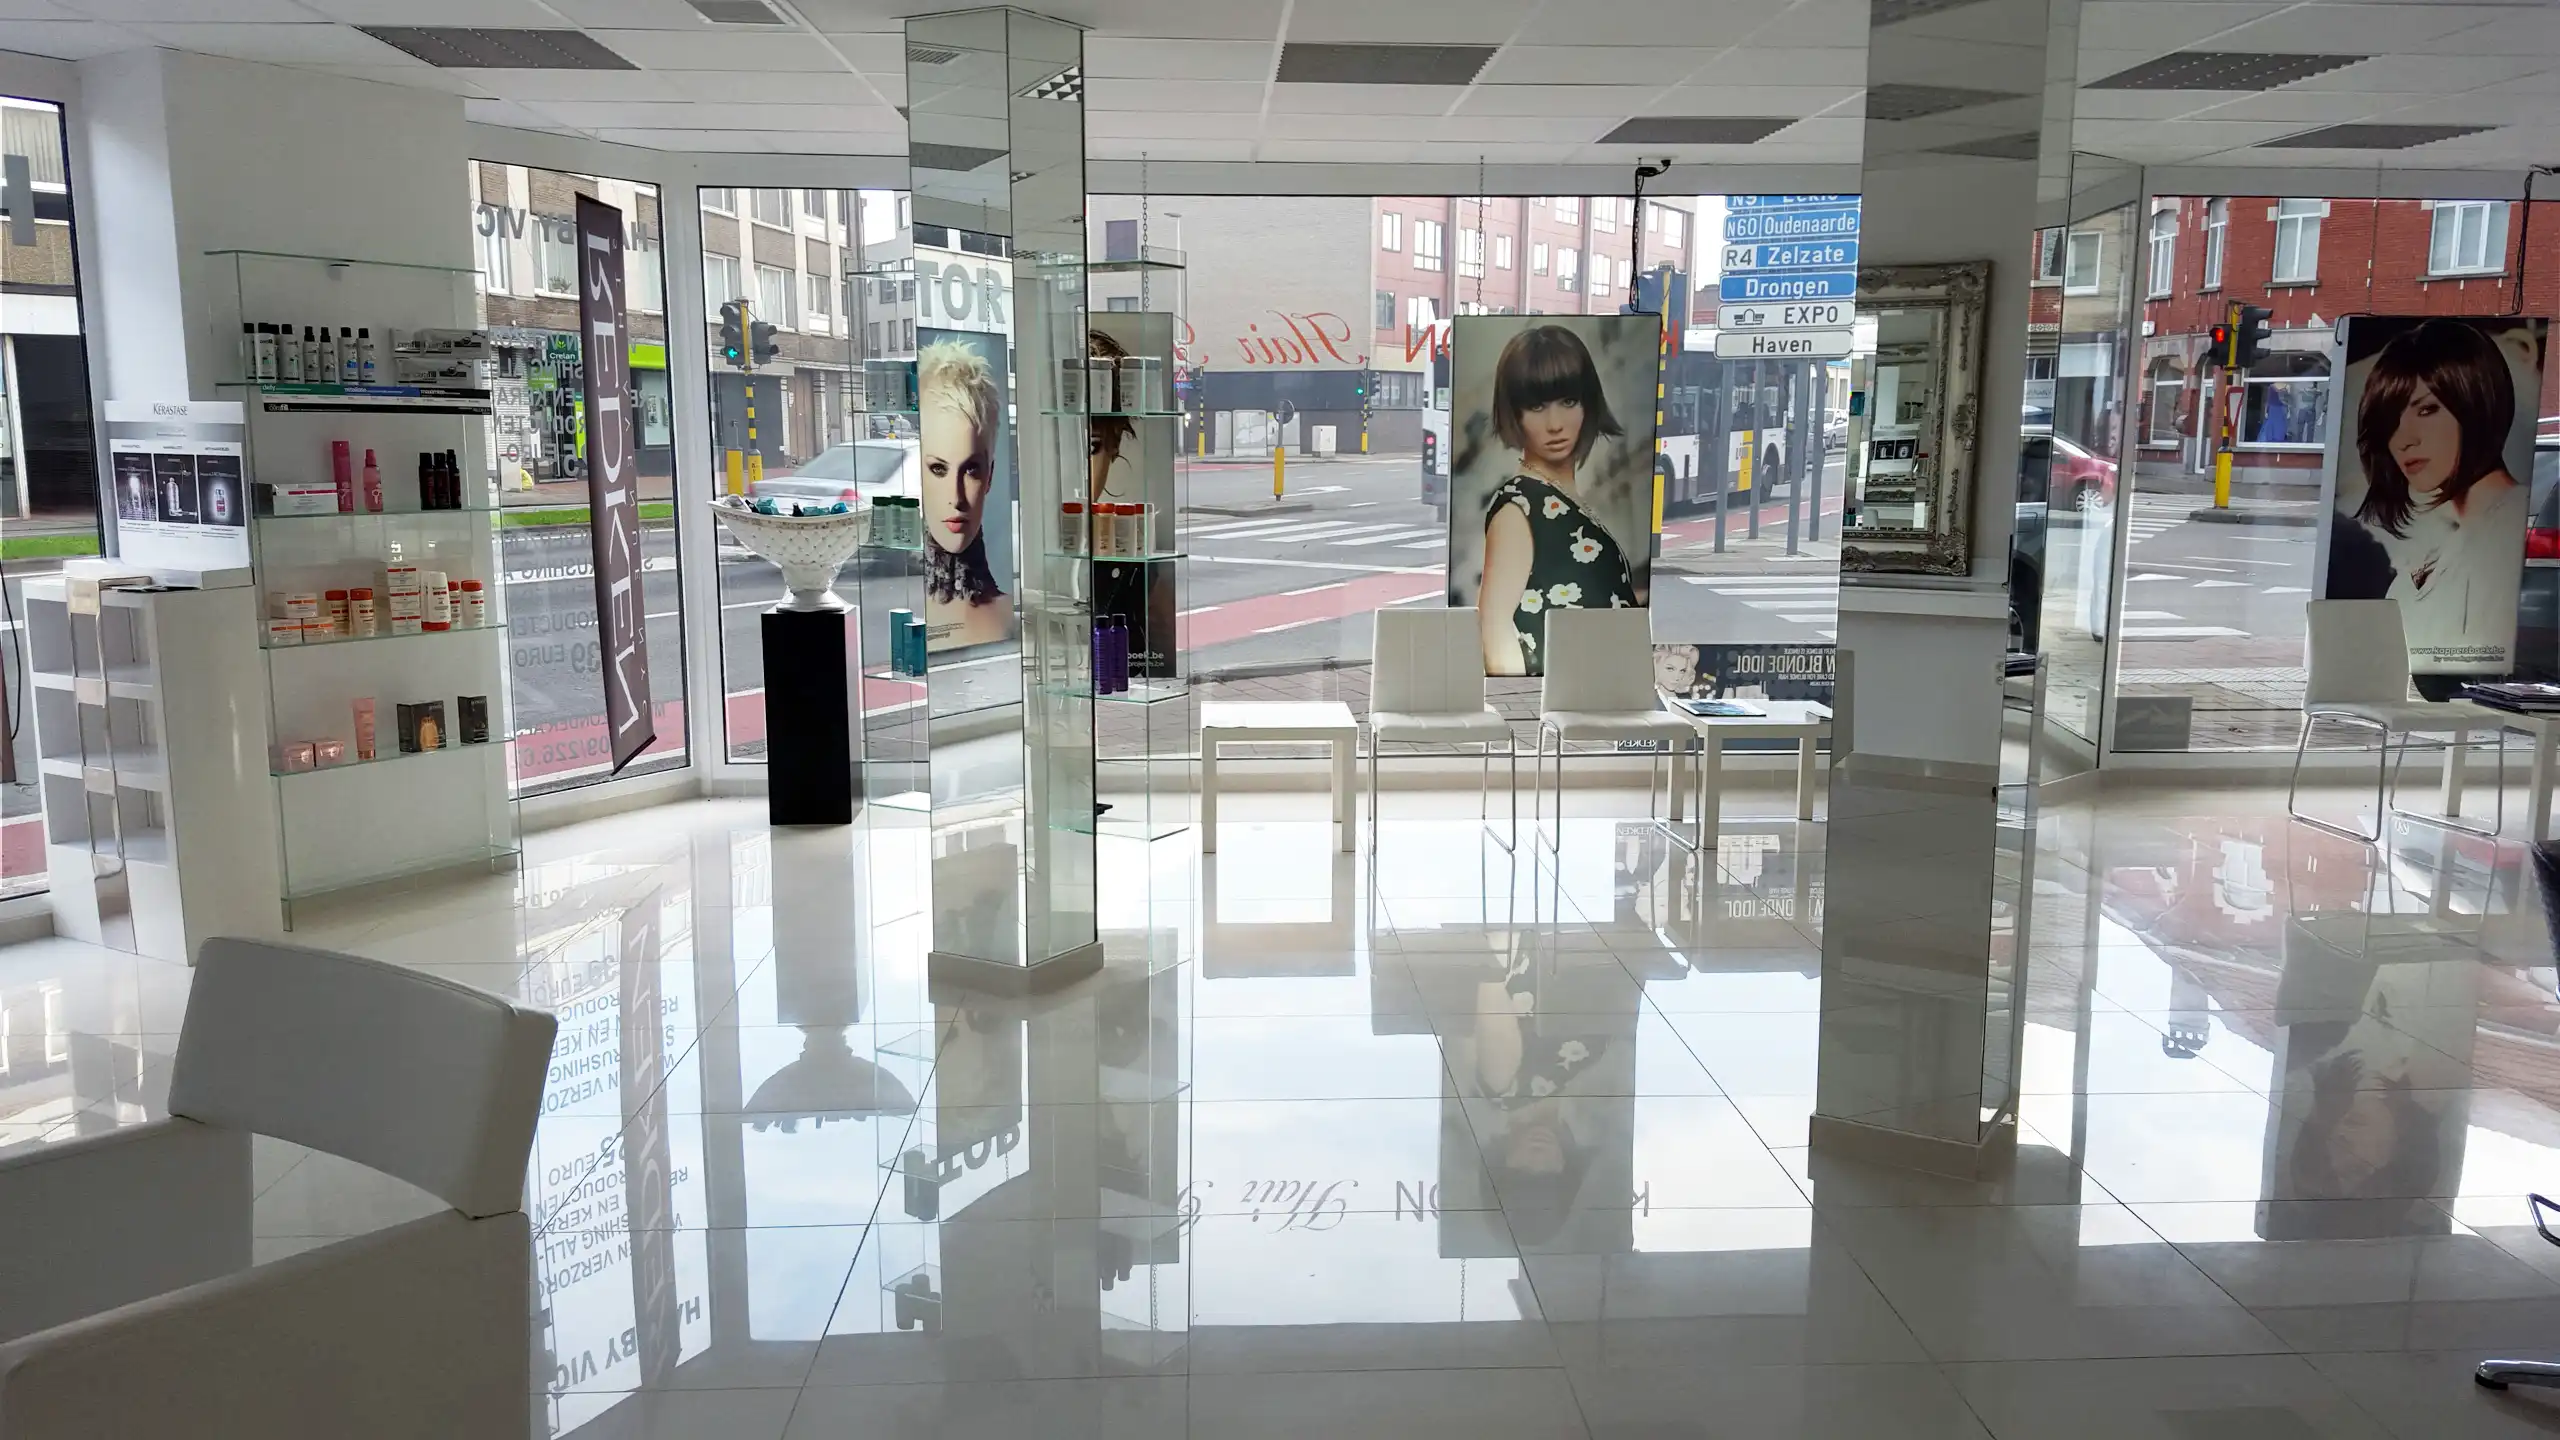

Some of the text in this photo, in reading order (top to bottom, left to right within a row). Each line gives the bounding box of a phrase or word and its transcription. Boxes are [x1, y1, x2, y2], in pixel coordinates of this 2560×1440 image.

[1727, 212, 1856, 238] N60 Oudenaarde
[1725, 244, 1845, 267] R4 Zelzate
[914, 259, 1007, 325] TOR
[1745, 278, 1829, 300] Drongen
[1784, 305, 1839, 325] EXPO
[1752, 336, 1812, 353] Haven
[549, 351, 576, 361] Crelan
